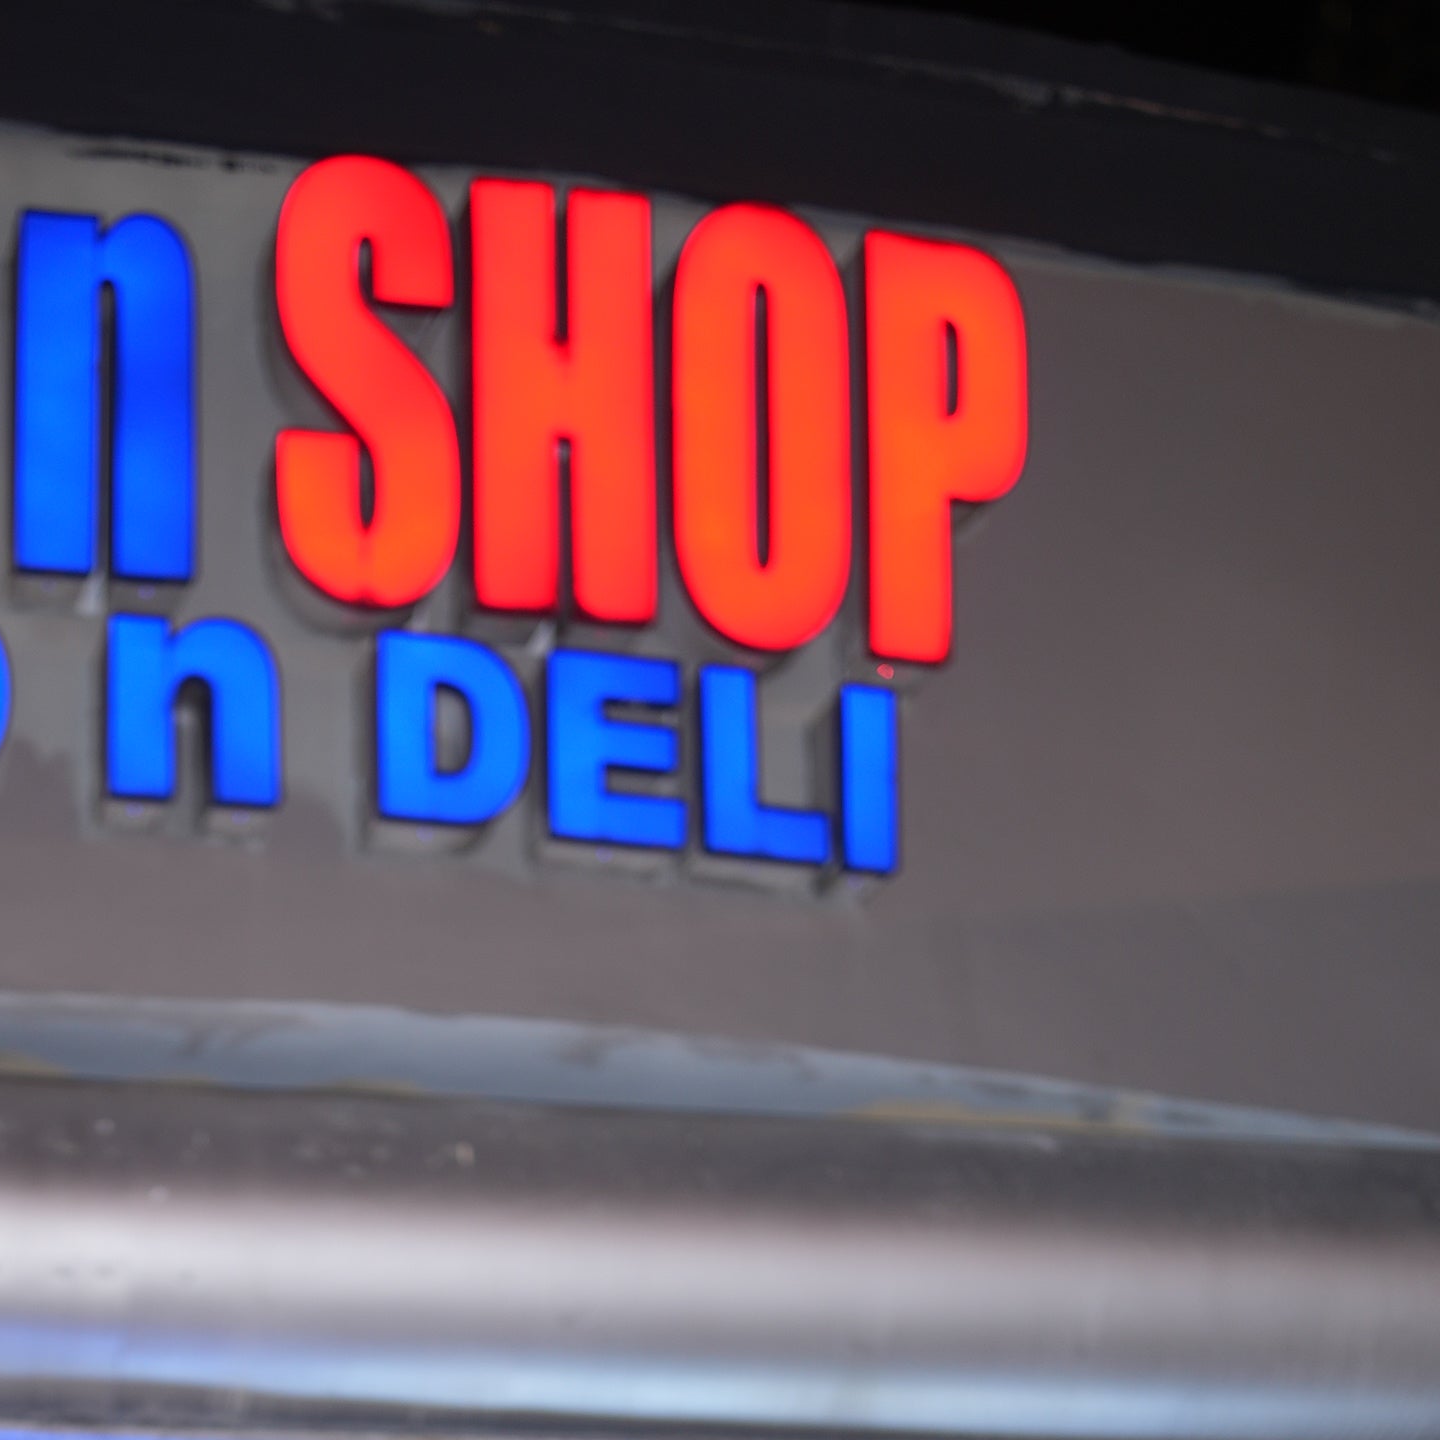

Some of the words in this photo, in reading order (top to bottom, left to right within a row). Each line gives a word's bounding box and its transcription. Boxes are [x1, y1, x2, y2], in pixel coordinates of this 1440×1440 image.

[11, 208, 198, 582] n
[273, 153, 1031, 664] SHOP
[104, 610, 282, 809] n
[373, 625, 900, 877] DELI
